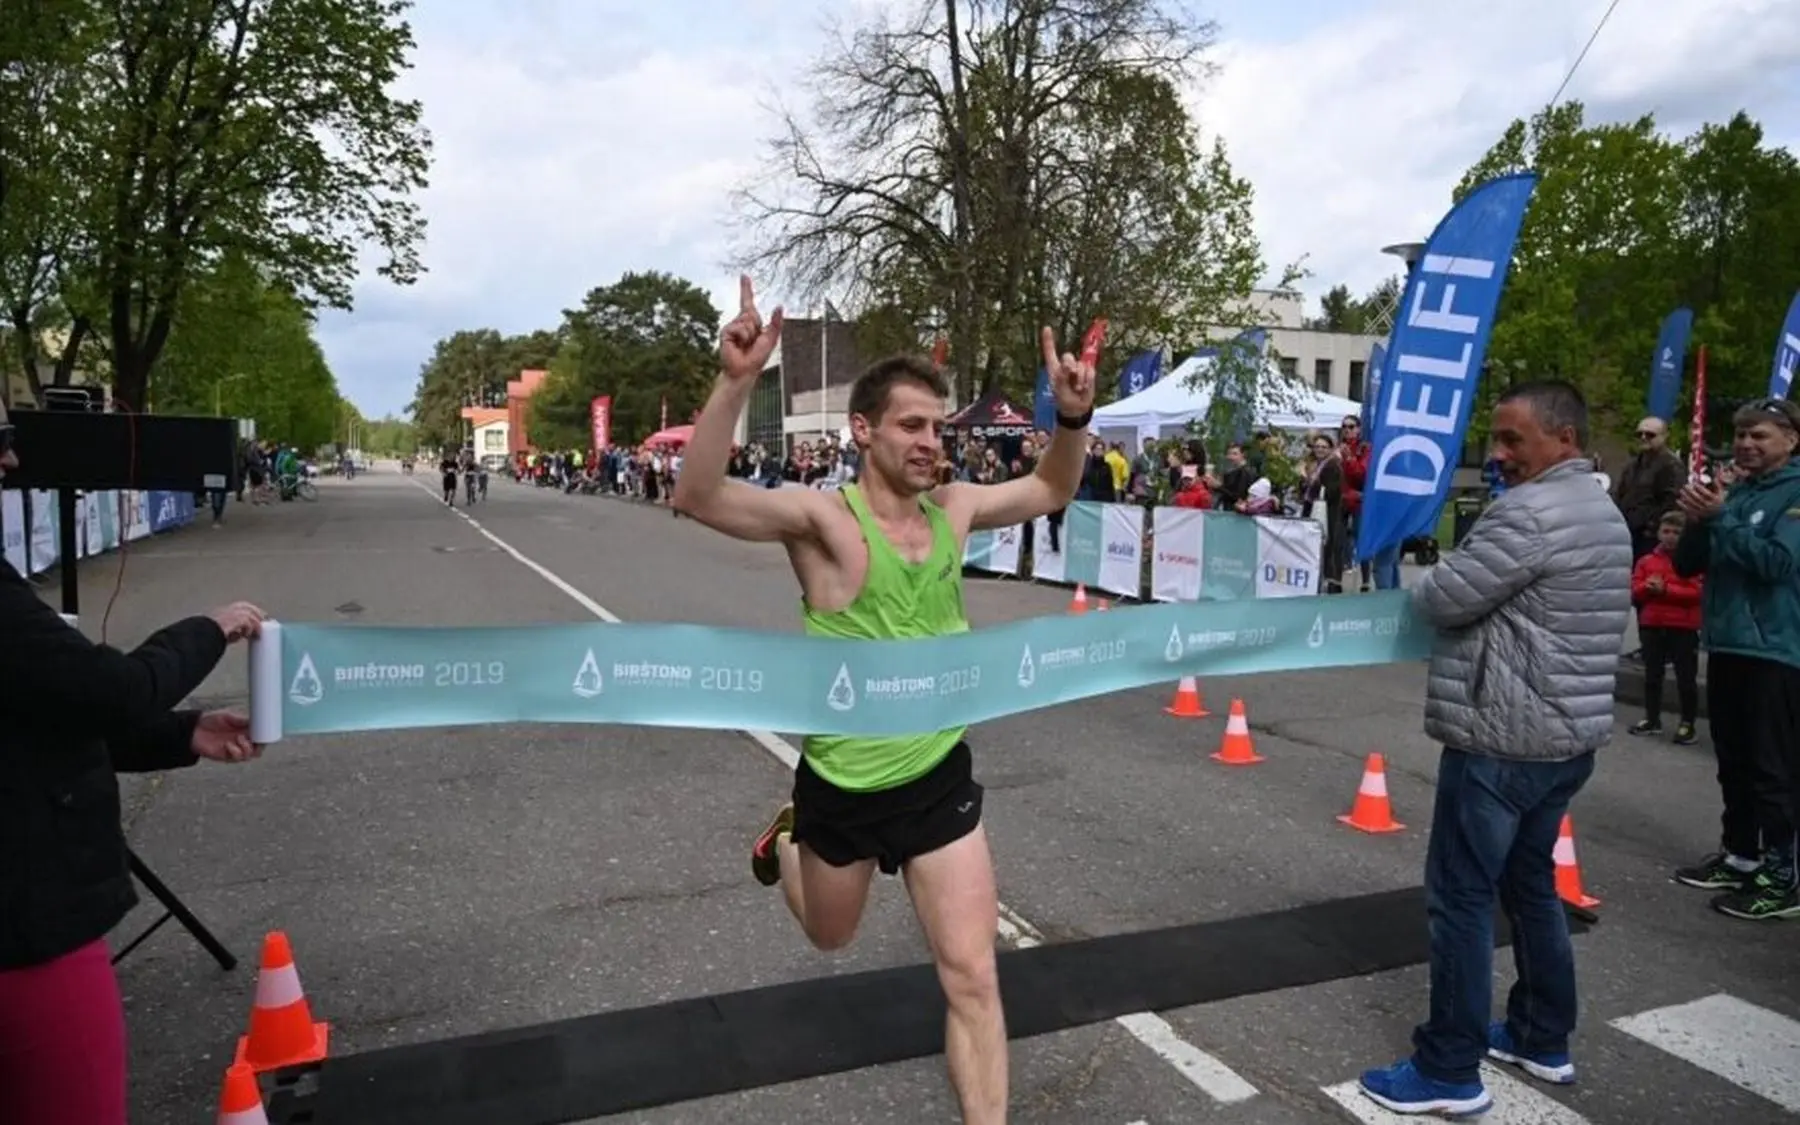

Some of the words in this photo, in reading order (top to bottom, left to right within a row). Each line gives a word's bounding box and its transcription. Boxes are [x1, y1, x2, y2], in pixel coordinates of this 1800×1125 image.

[1374, 254, 1496, 496] DELFI
[1264, 563, 1310, 589] DELFI
[335, 662, 424, 681] BIRŠTONO
[434, 661, 504, 687] 2019
[613, 659, 692, 680] BIRŠTONO
[700, 665, 763, 692] 2019
[939, 664, 980, 696] 2019
